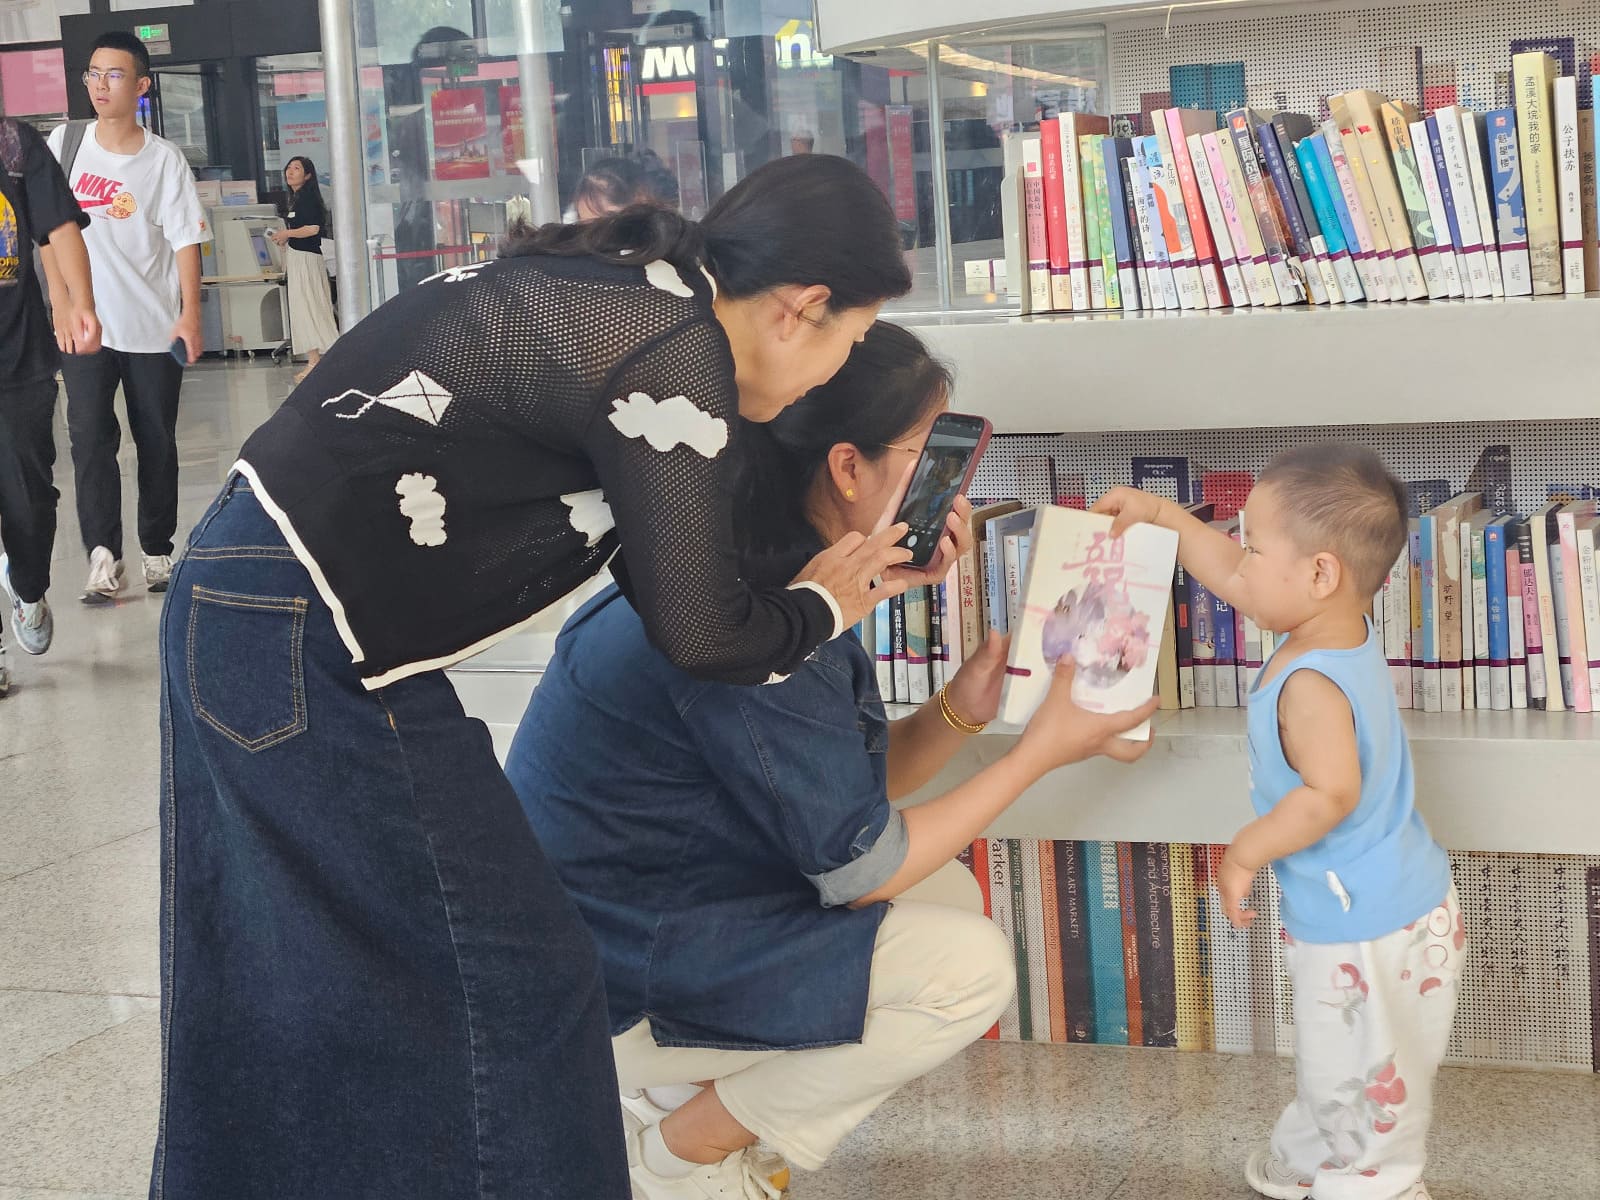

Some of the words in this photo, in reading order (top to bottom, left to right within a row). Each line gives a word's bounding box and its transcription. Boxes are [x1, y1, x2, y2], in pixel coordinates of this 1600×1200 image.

[1562, 124, 1576, 172] 公子扶苏
[75, 172, 123, 199] NIKE
[1147, 858, 1157, 879] and
[1159, 842, 1170, 882] panion
[1067, 877, 1076, 897] ART
[1162, 886, 1170, 897] to
[1148, 881, 1161, 949] Architecture
